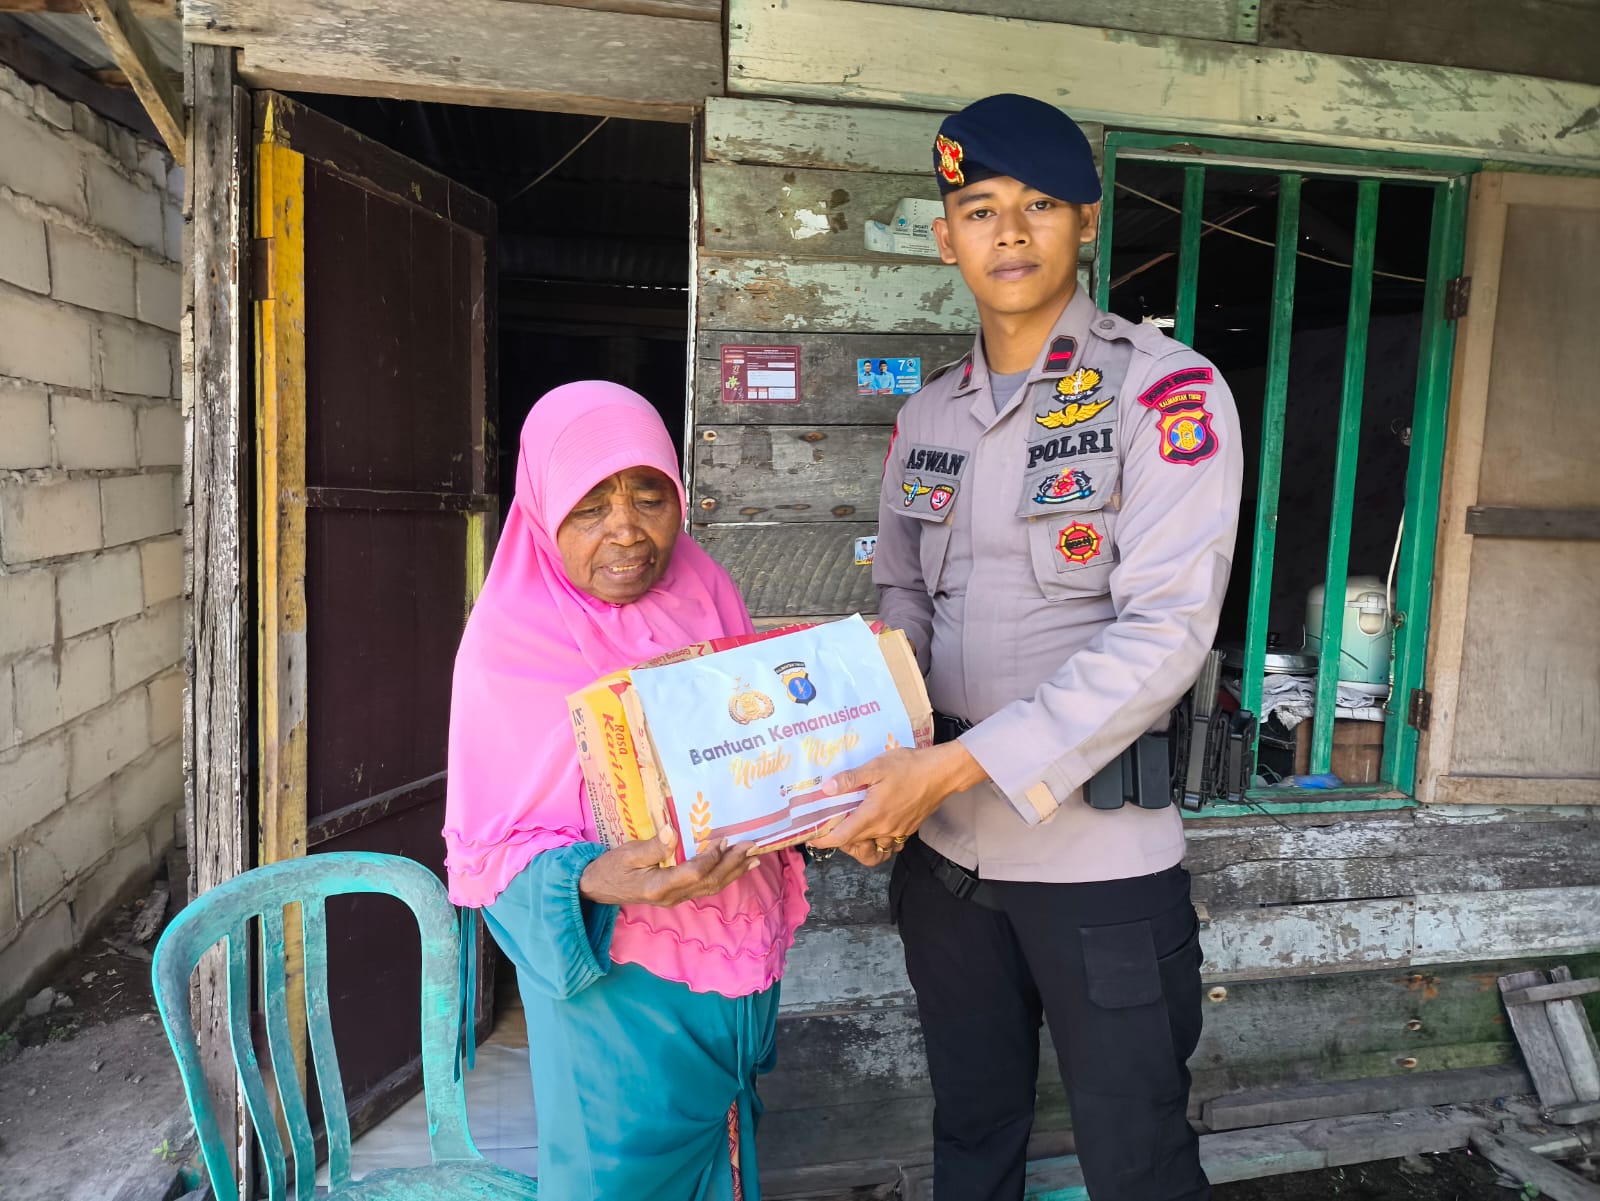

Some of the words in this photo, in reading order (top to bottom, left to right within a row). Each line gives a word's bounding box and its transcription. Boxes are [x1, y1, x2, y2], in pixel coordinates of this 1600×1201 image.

[898, 359, 906, 372] 7
[906, 448, 965, 476] ASWAN
[1028, 428, 1114, 469] POLRI
[604, 712, 624, 771] Kari
[614, 723, 629, 756] Rasa
[689, 732, 767, 766] Bantuan
[767, 700, 881, 741] Kemanusiaan
[730, 743, 792, 790] Untuk
